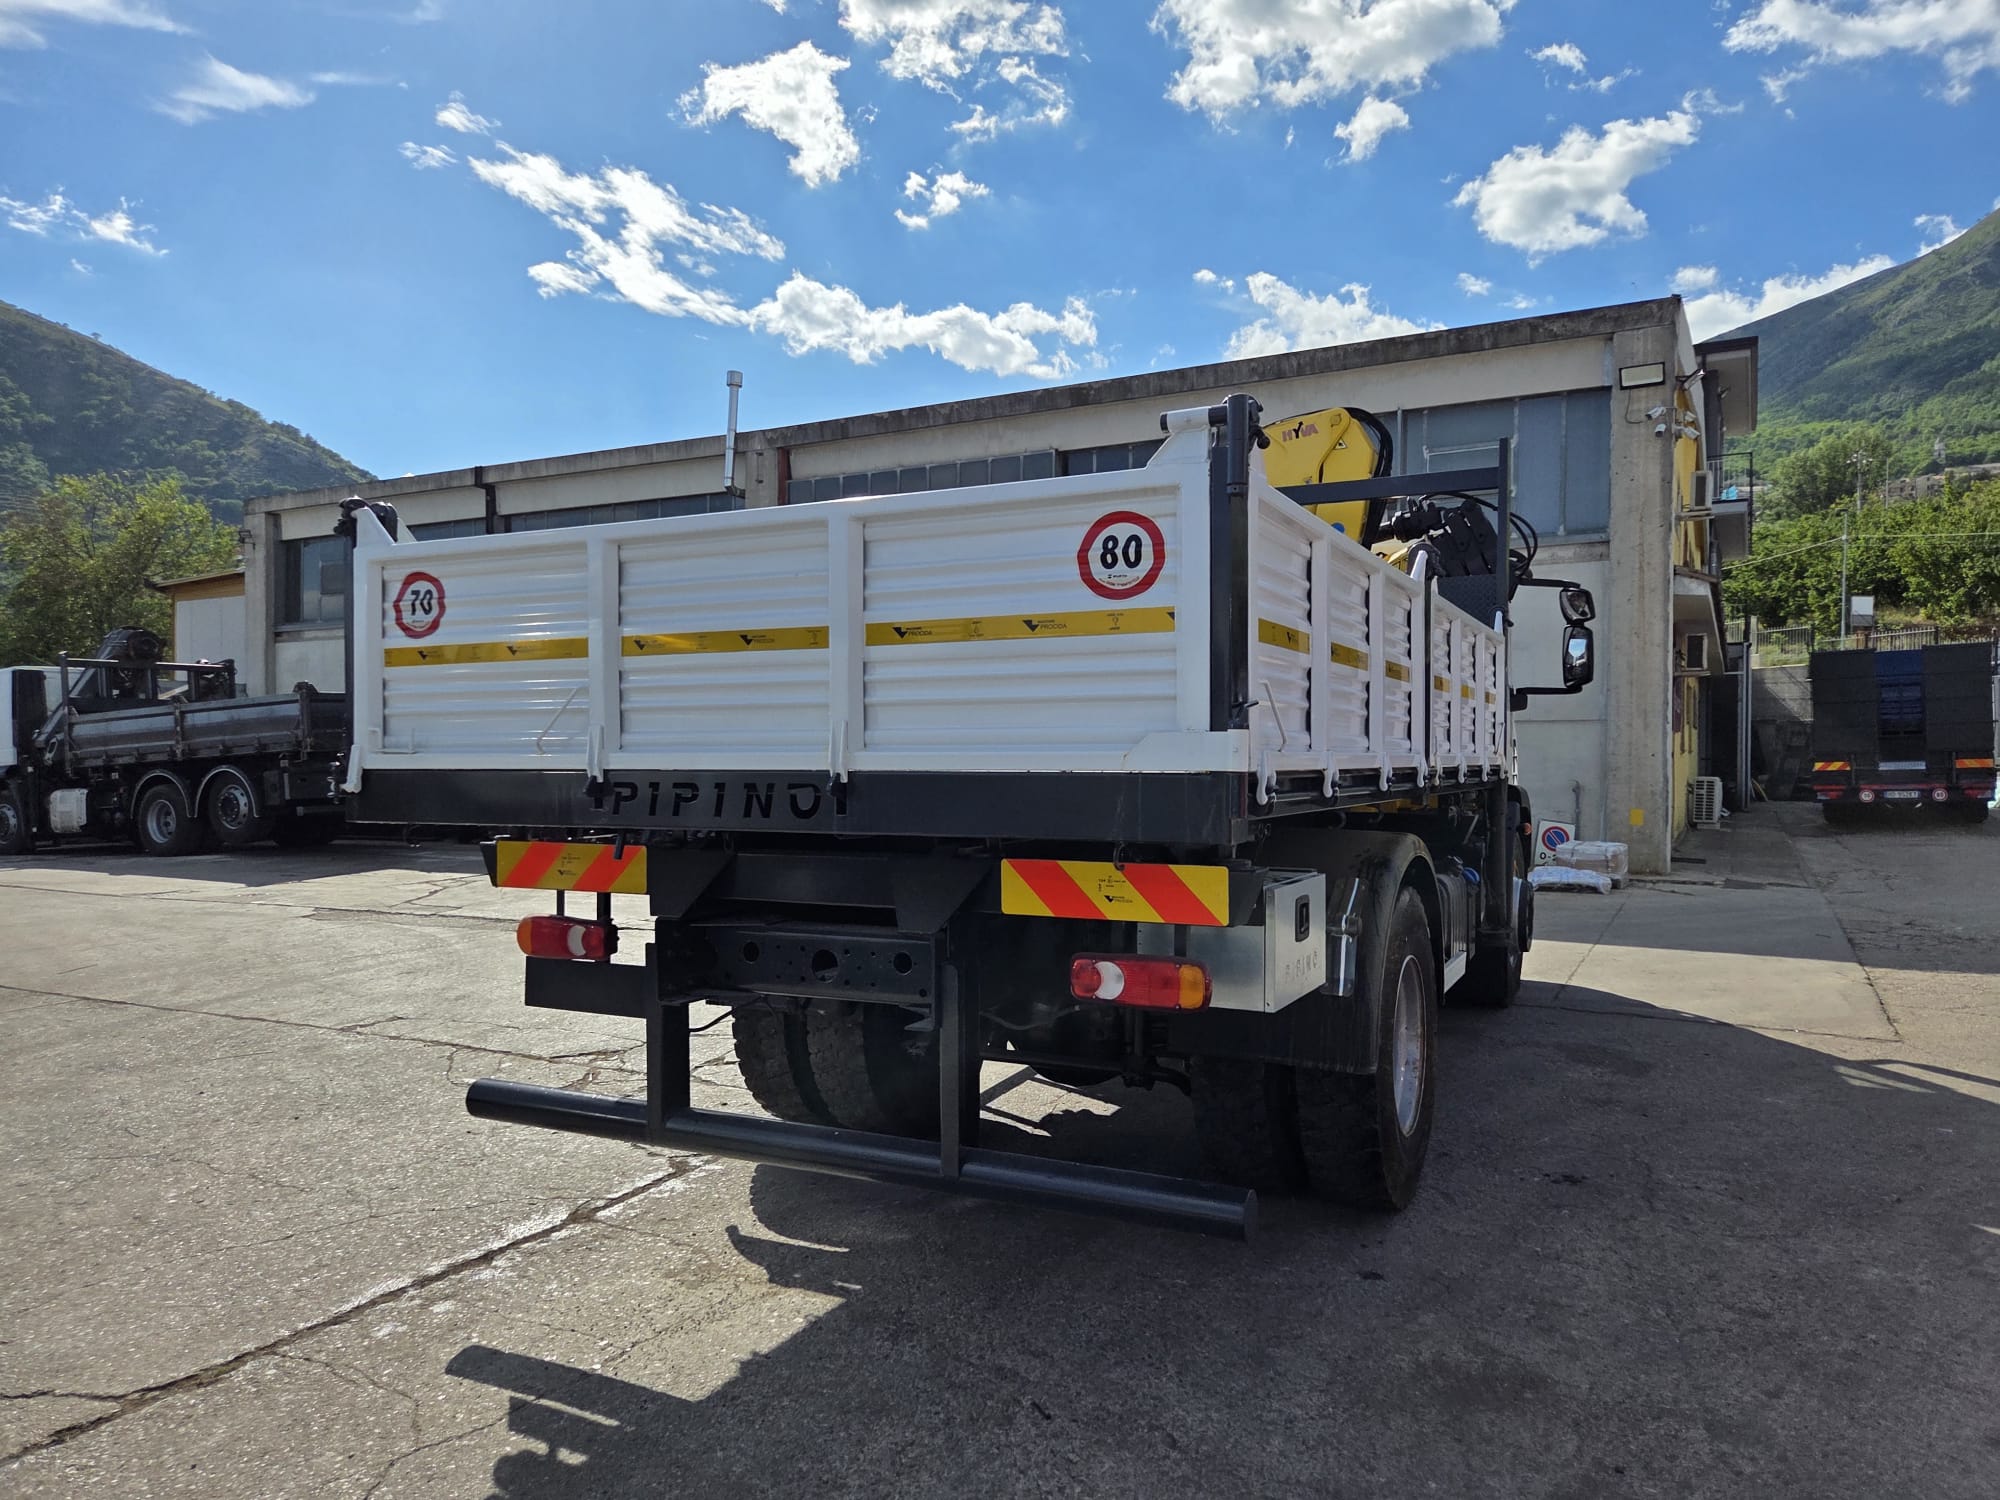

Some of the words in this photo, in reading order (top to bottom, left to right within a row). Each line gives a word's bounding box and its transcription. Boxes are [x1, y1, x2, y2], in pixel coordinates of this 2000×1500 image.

[1281, 421, 1319, 442] HYVA
[1100, 534, 1143, 570] 80
[411, 588, 433, 616] 70
[612, 781, 822, 819] PIPINO
[1540, 852, 1557, 861] 0-2
